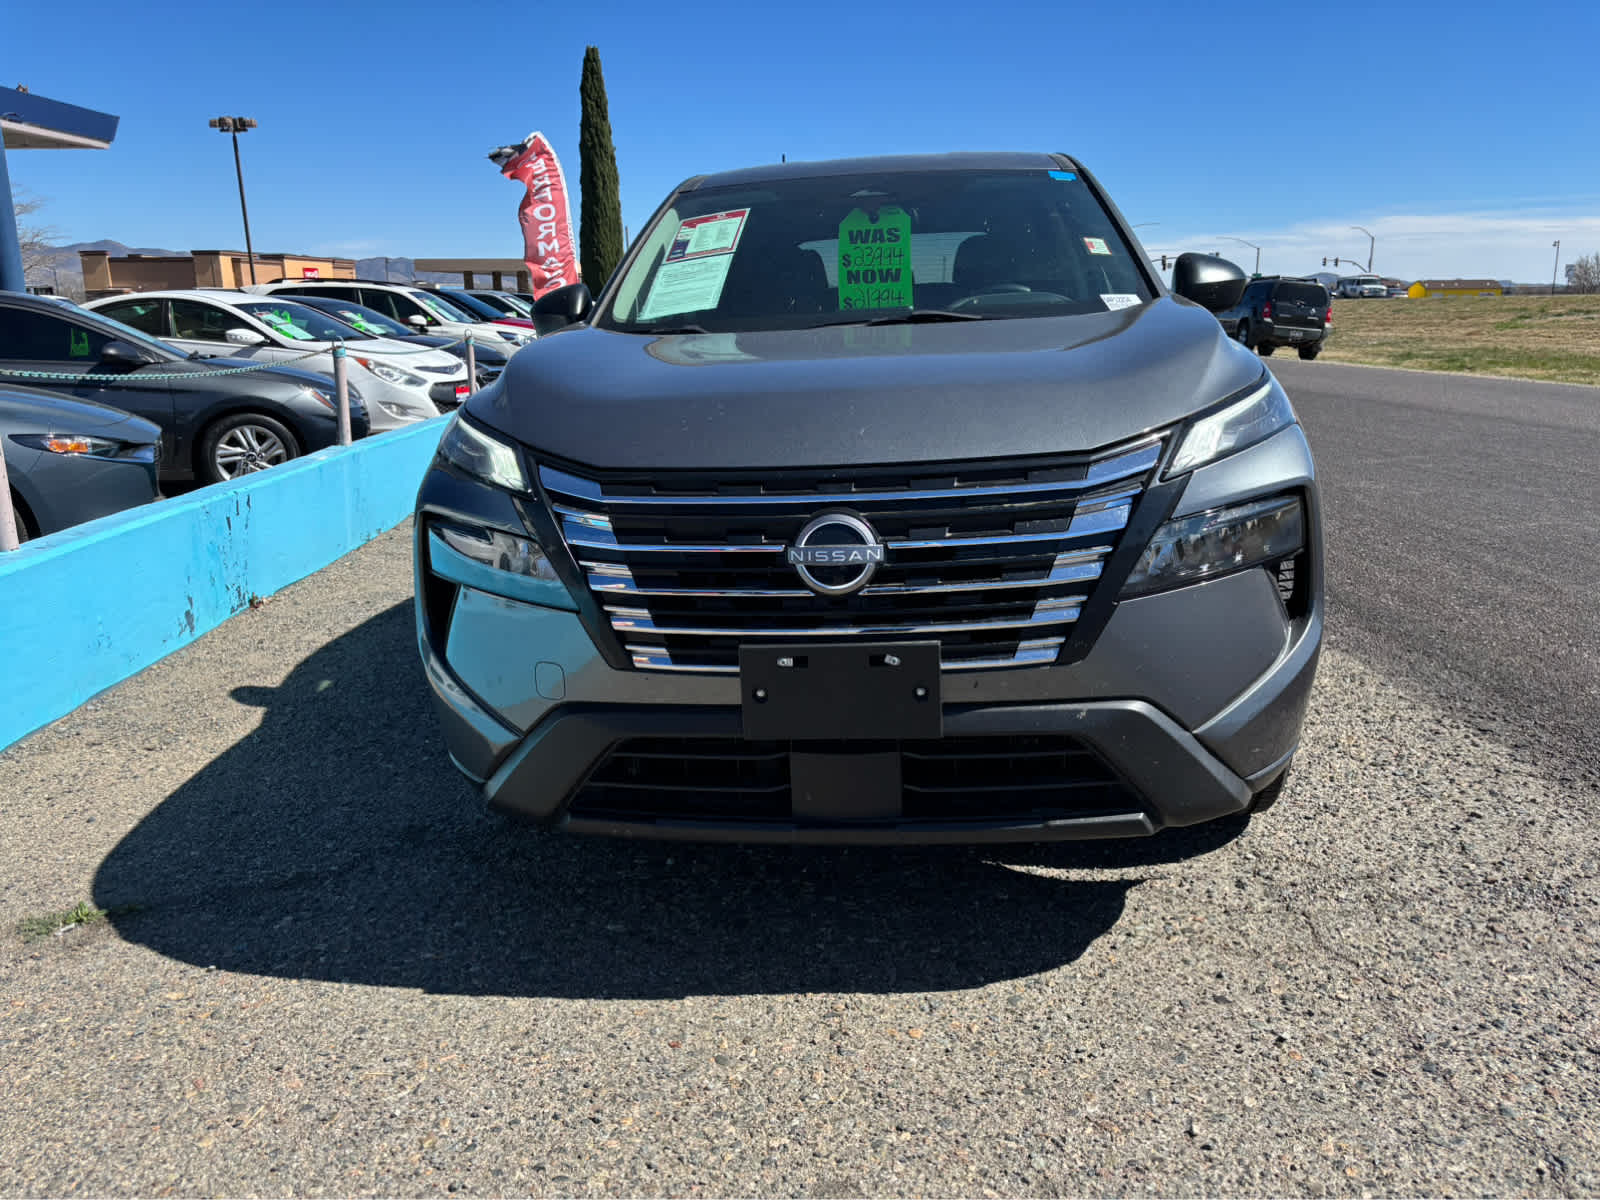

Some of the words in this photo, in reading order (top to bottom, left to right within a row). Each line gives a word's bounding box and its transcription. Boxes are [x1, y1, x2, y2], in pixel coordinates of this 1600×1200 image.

[848, 227, 901, 244] WAS
[846, 268, 902, 285] NOW
[790, 549, 881, 562] NISSAN
